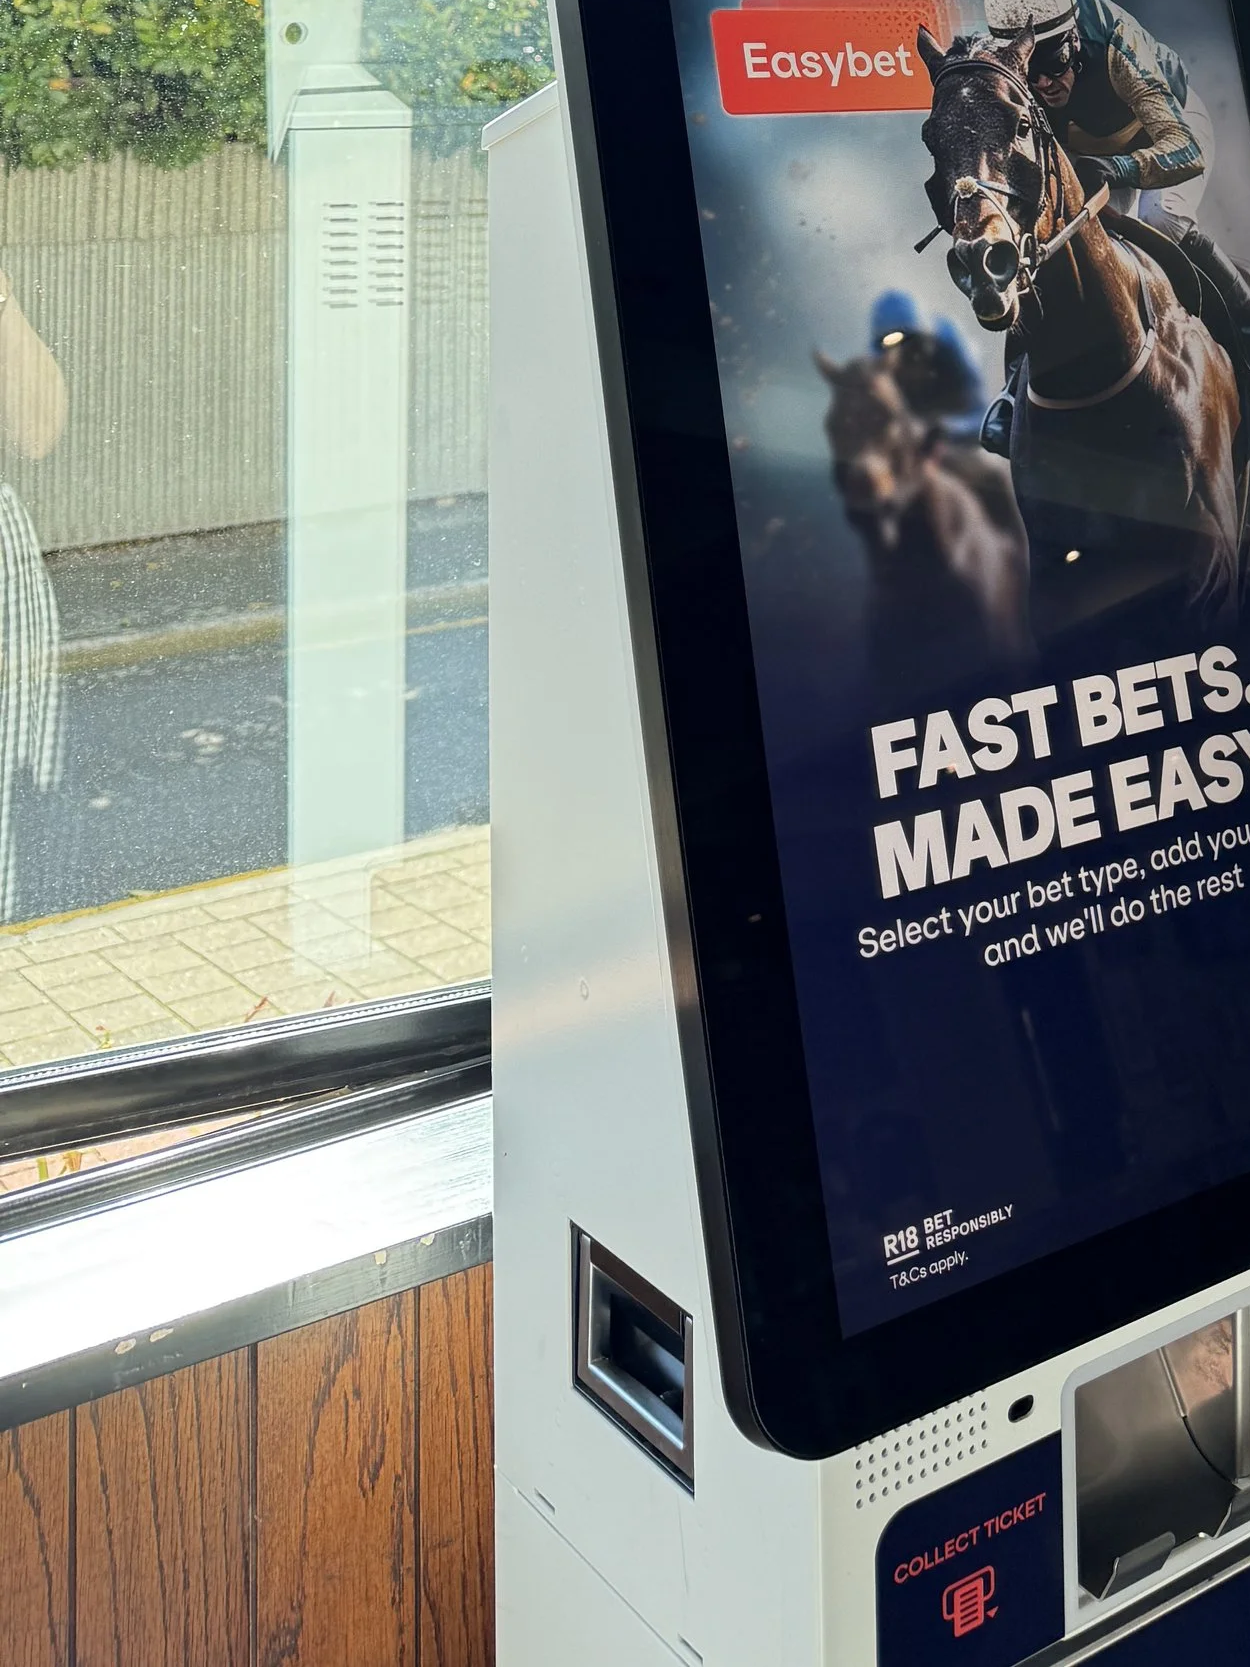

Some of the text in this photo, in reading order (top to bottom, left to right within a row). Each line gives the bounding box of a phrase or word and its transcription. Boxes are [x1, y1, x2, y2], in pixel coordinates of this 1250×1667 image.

[743, 42, 914, 86] Easybet
[871, 685, 1058, 799] FAST
[873, 770, 1101, 900] MADE
[858, 906, 953, 959] Select
[958, 890, 1019, 937] your
[1027, 872, 1075, 909] bet
[1078, 859, 1146, 898] type,
[1150, 838, 1202, 872] add
[984, 864, 1246, 968] and we'll do the rest
[884, 1226, 919, 1258] R18
[924, 1209, 953, 1234] BET
[926, 1204, 1014, 1250] RESPONSIBLY
[890, 1250, 969, 1290] T&Cs apply.
[894, 1492, 1047, 1585] COLLECT TICKET
